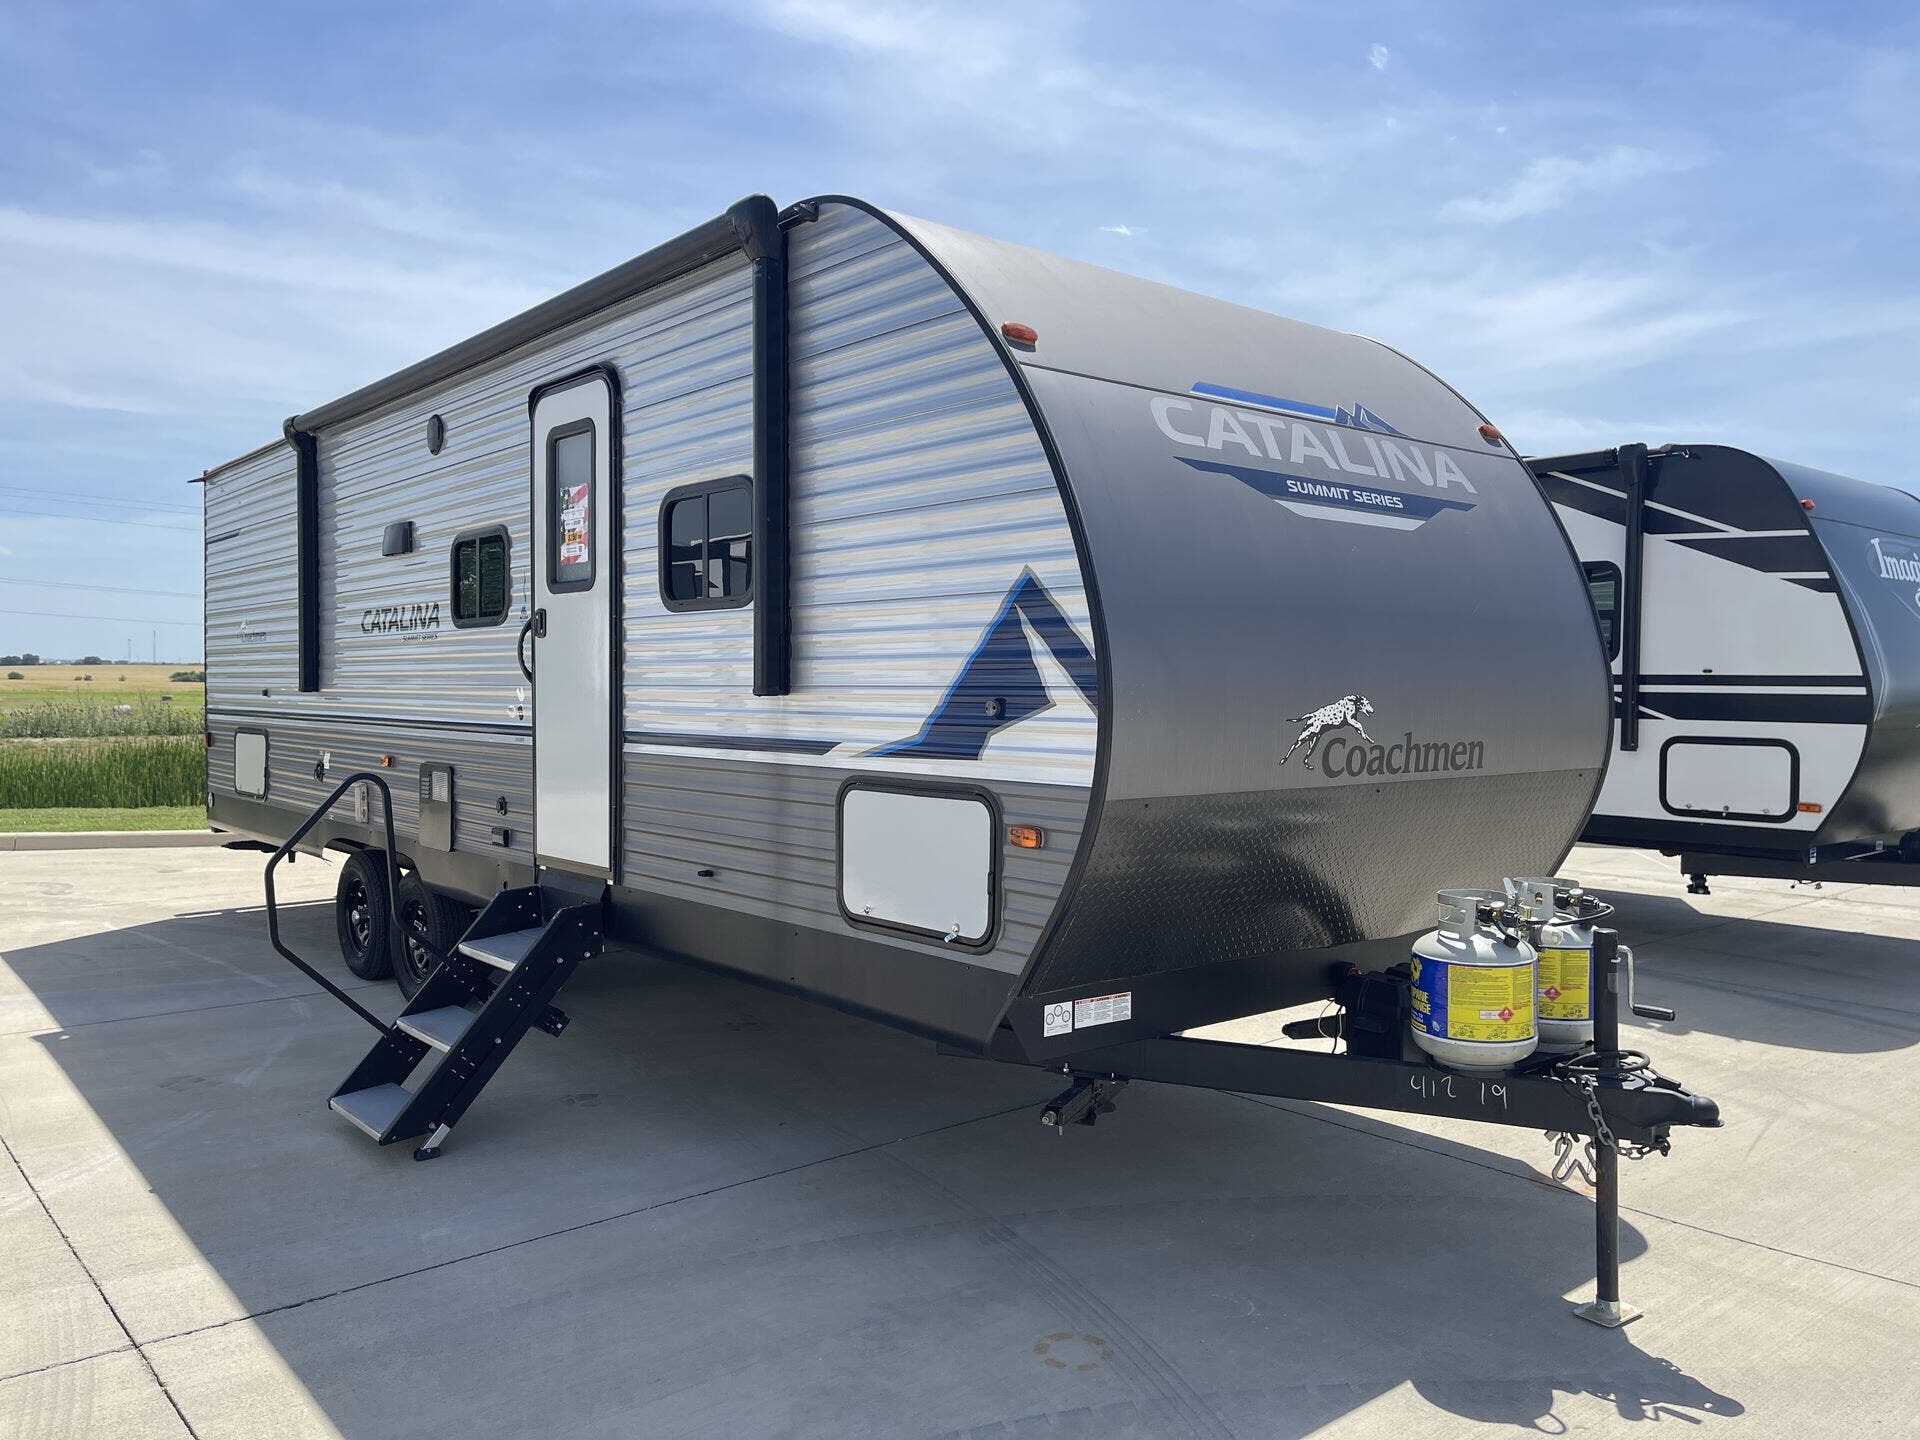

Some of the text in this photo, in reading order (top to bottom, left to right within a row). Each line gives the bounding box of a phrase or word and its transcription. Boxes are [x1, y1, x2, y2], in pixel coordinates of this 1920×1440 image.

[1150, 396, 1478, 494] CATALINA
[1286, 479, 1404, 509] SUMMIT SERIES
[361, 602, 440, 634] CATALINA
[1322, 732, 1484, 778] Coachmen
[1410, 1075, 1507, 1109] 412 19
